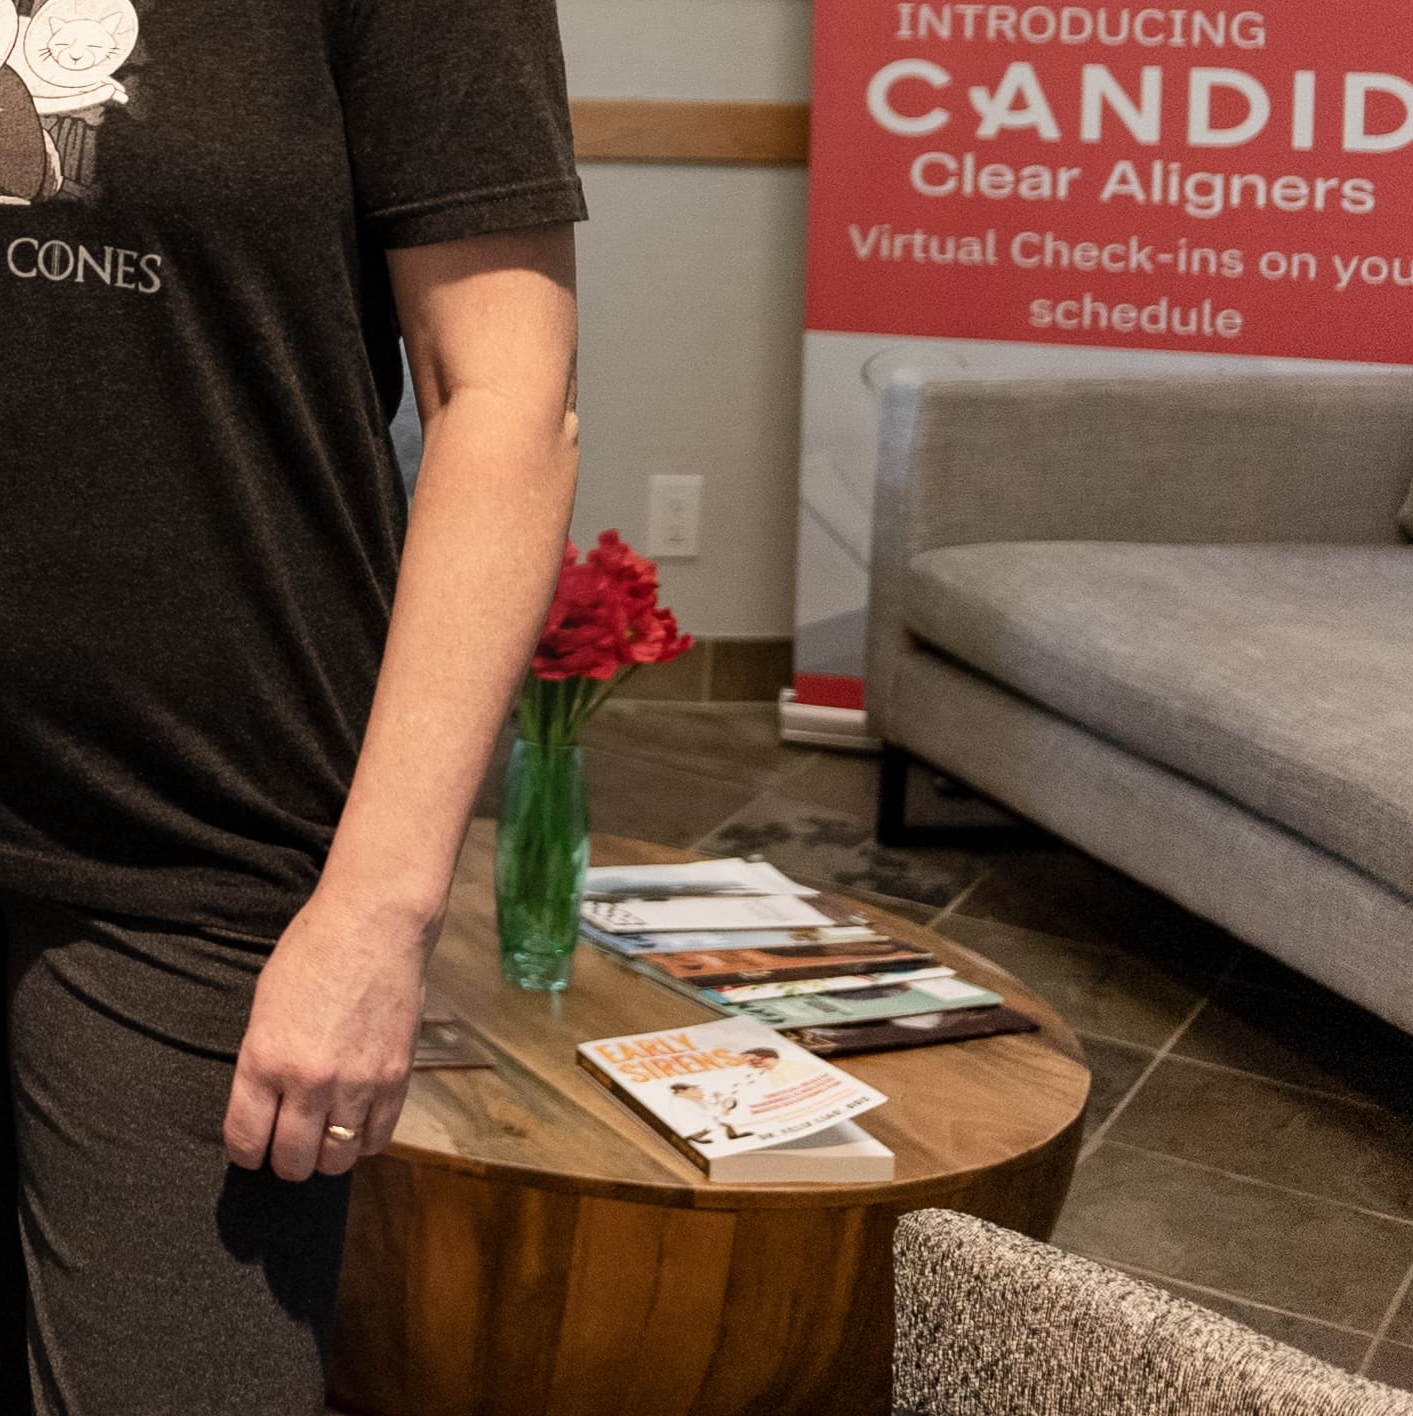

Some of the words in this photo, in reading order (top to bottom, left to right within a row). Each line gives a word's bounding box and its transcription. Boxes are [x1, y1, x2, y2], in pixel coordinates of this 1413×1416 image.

[895, 2, 1266, 48] INTRODUCING
[866, 58, 1413, 153] CANDID
[909, 151, 1081, 200] Clear
[1100, 159, 1376, 219] Aligners
[7, 237, 163, 294] CONES
[848, 223, 997, 267] Virtual
[1010, 230, 1245, 278] Check-ins
[1258, 251, 1318, 281] on
[1029, 292, 1244, 338] schedule
[596, 1033, 697, 1064] EARLY
